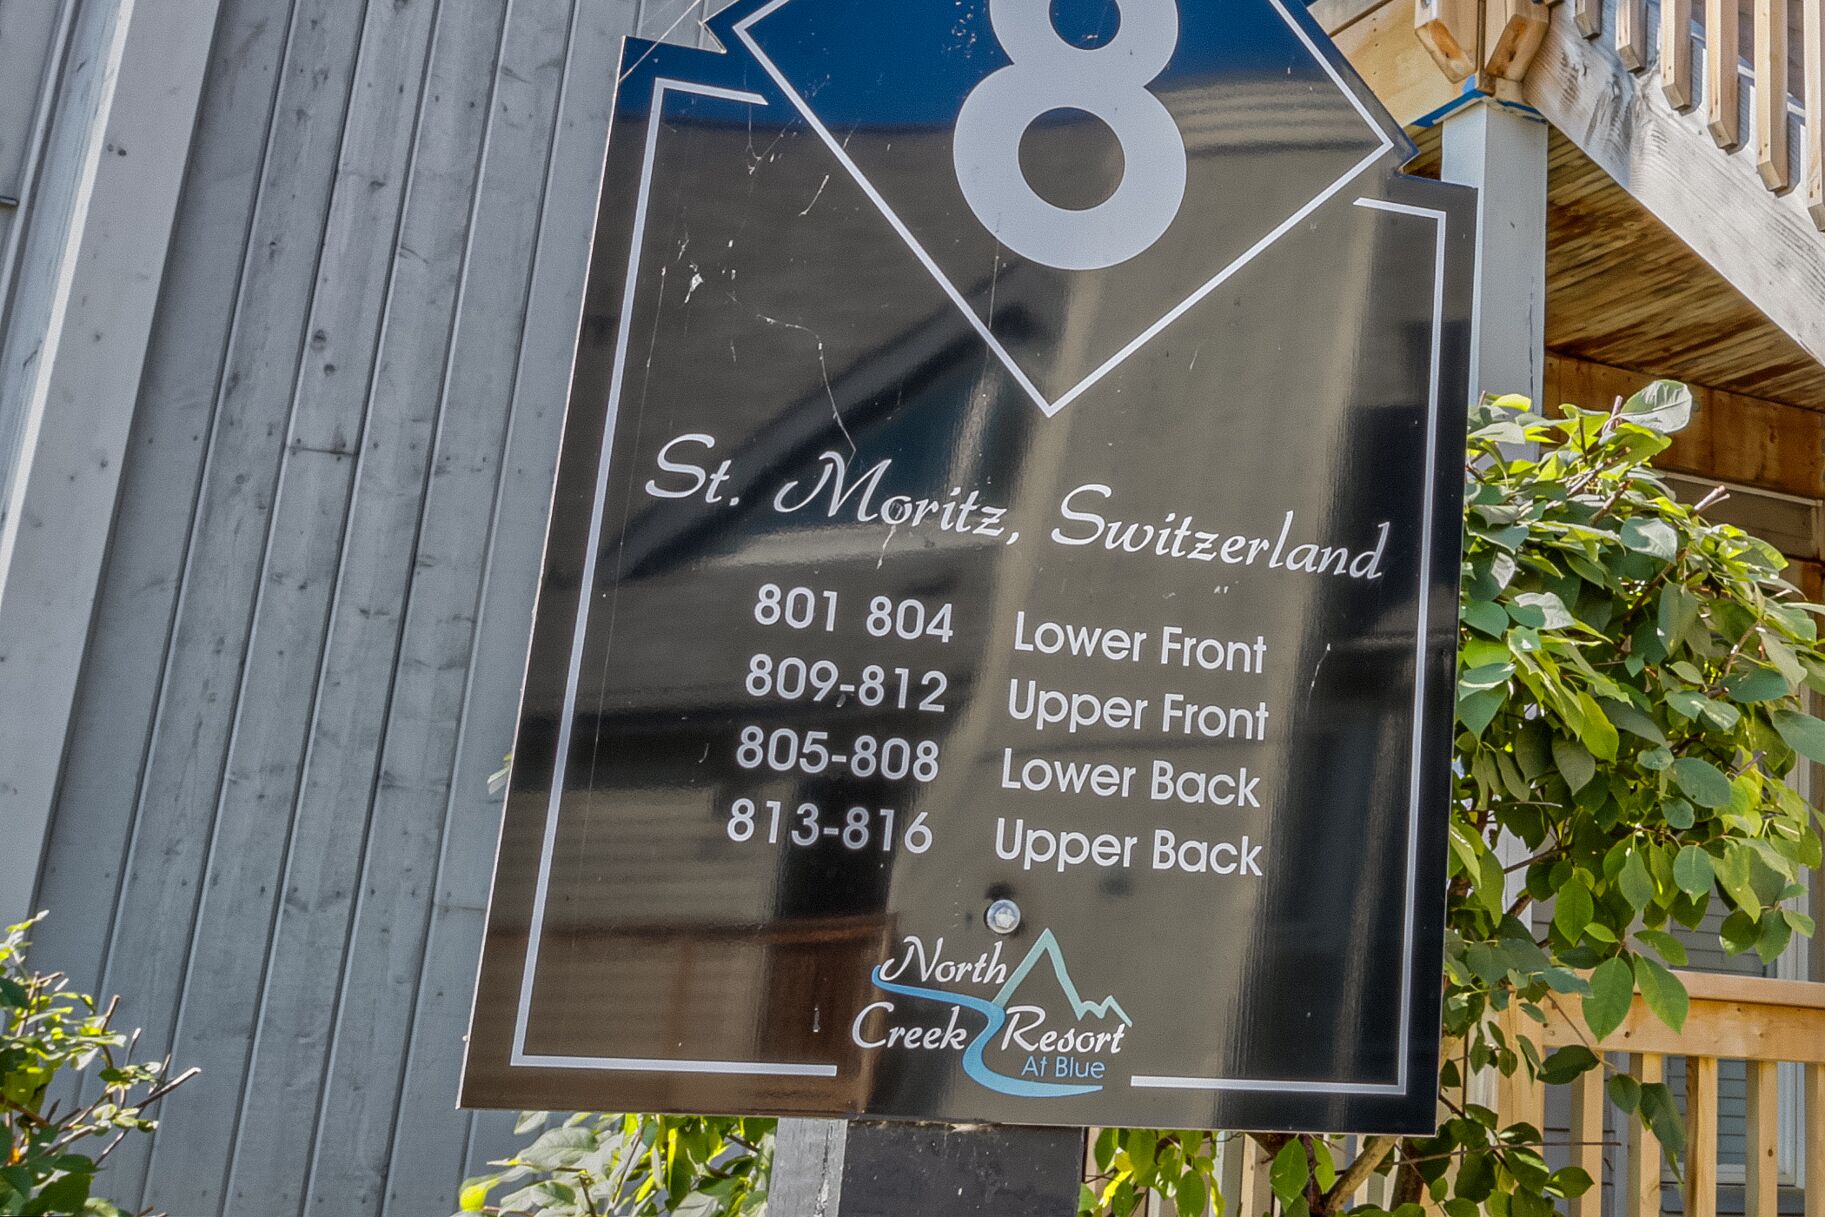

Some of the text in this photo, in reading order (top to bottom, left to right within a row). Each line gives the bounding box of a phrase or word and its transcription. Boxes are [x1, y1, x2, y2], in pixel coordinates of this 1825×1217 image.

[645, 434, 1391, 580] St. Moritz, Switzerland
[754, 584, 953, 643] 801 804
[1014, 611, 1267, 674] Lower Front
[745, 654, 948, 713] 809-812
[1008, 679, 1269, 741] Upper Front
[736, 726, 939, 782] 805-808
[1001, 748, 1261, 808] Lower Back
[727, 798, 933, 854] 813-816
[995, 817, 1263, 877] Upper Back
[878, 935, 1008, 984] North
[852, 1002, 1126, 1054] Creek Resort
[1021, 1056, 1106, 1079] At Blue
